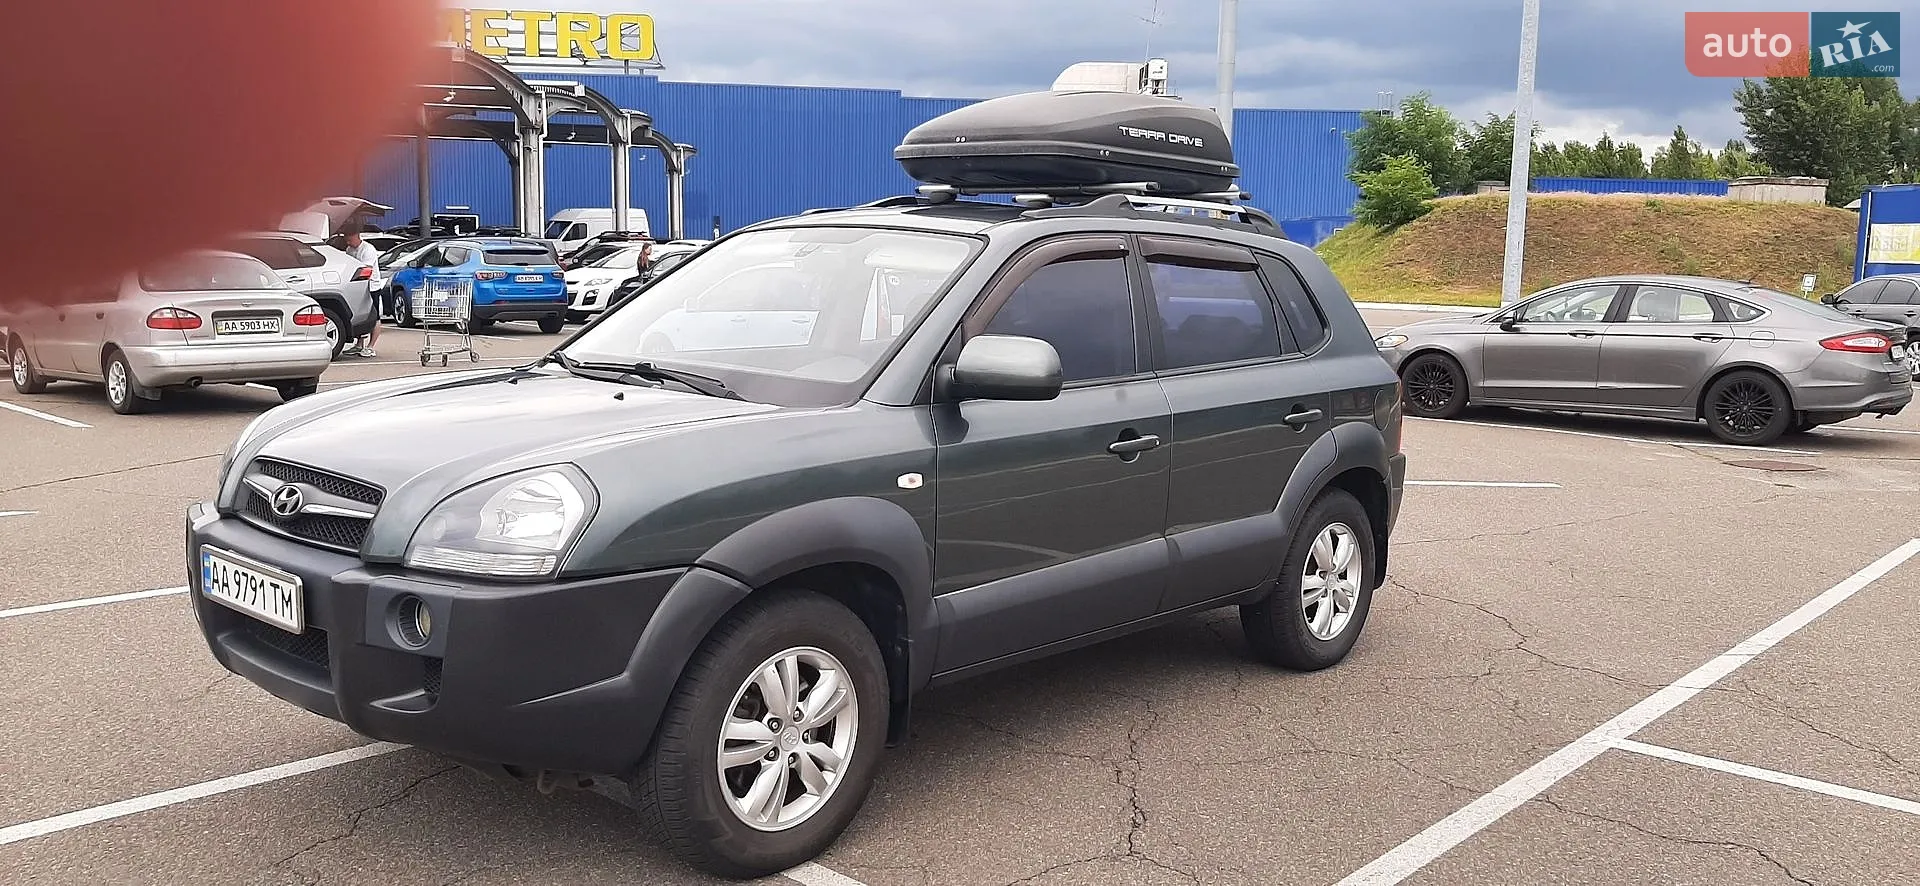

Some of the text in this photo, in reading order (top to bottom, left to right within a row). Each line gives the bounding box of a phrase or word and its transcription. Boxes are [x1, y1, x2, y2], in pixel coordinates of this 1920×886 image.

[1118, 126, 1204, 147] TERRA DRIVE
[224, 320, 276, 331] AA 5903 HX
[211, 561, 293, 621] AA 9791 TM
